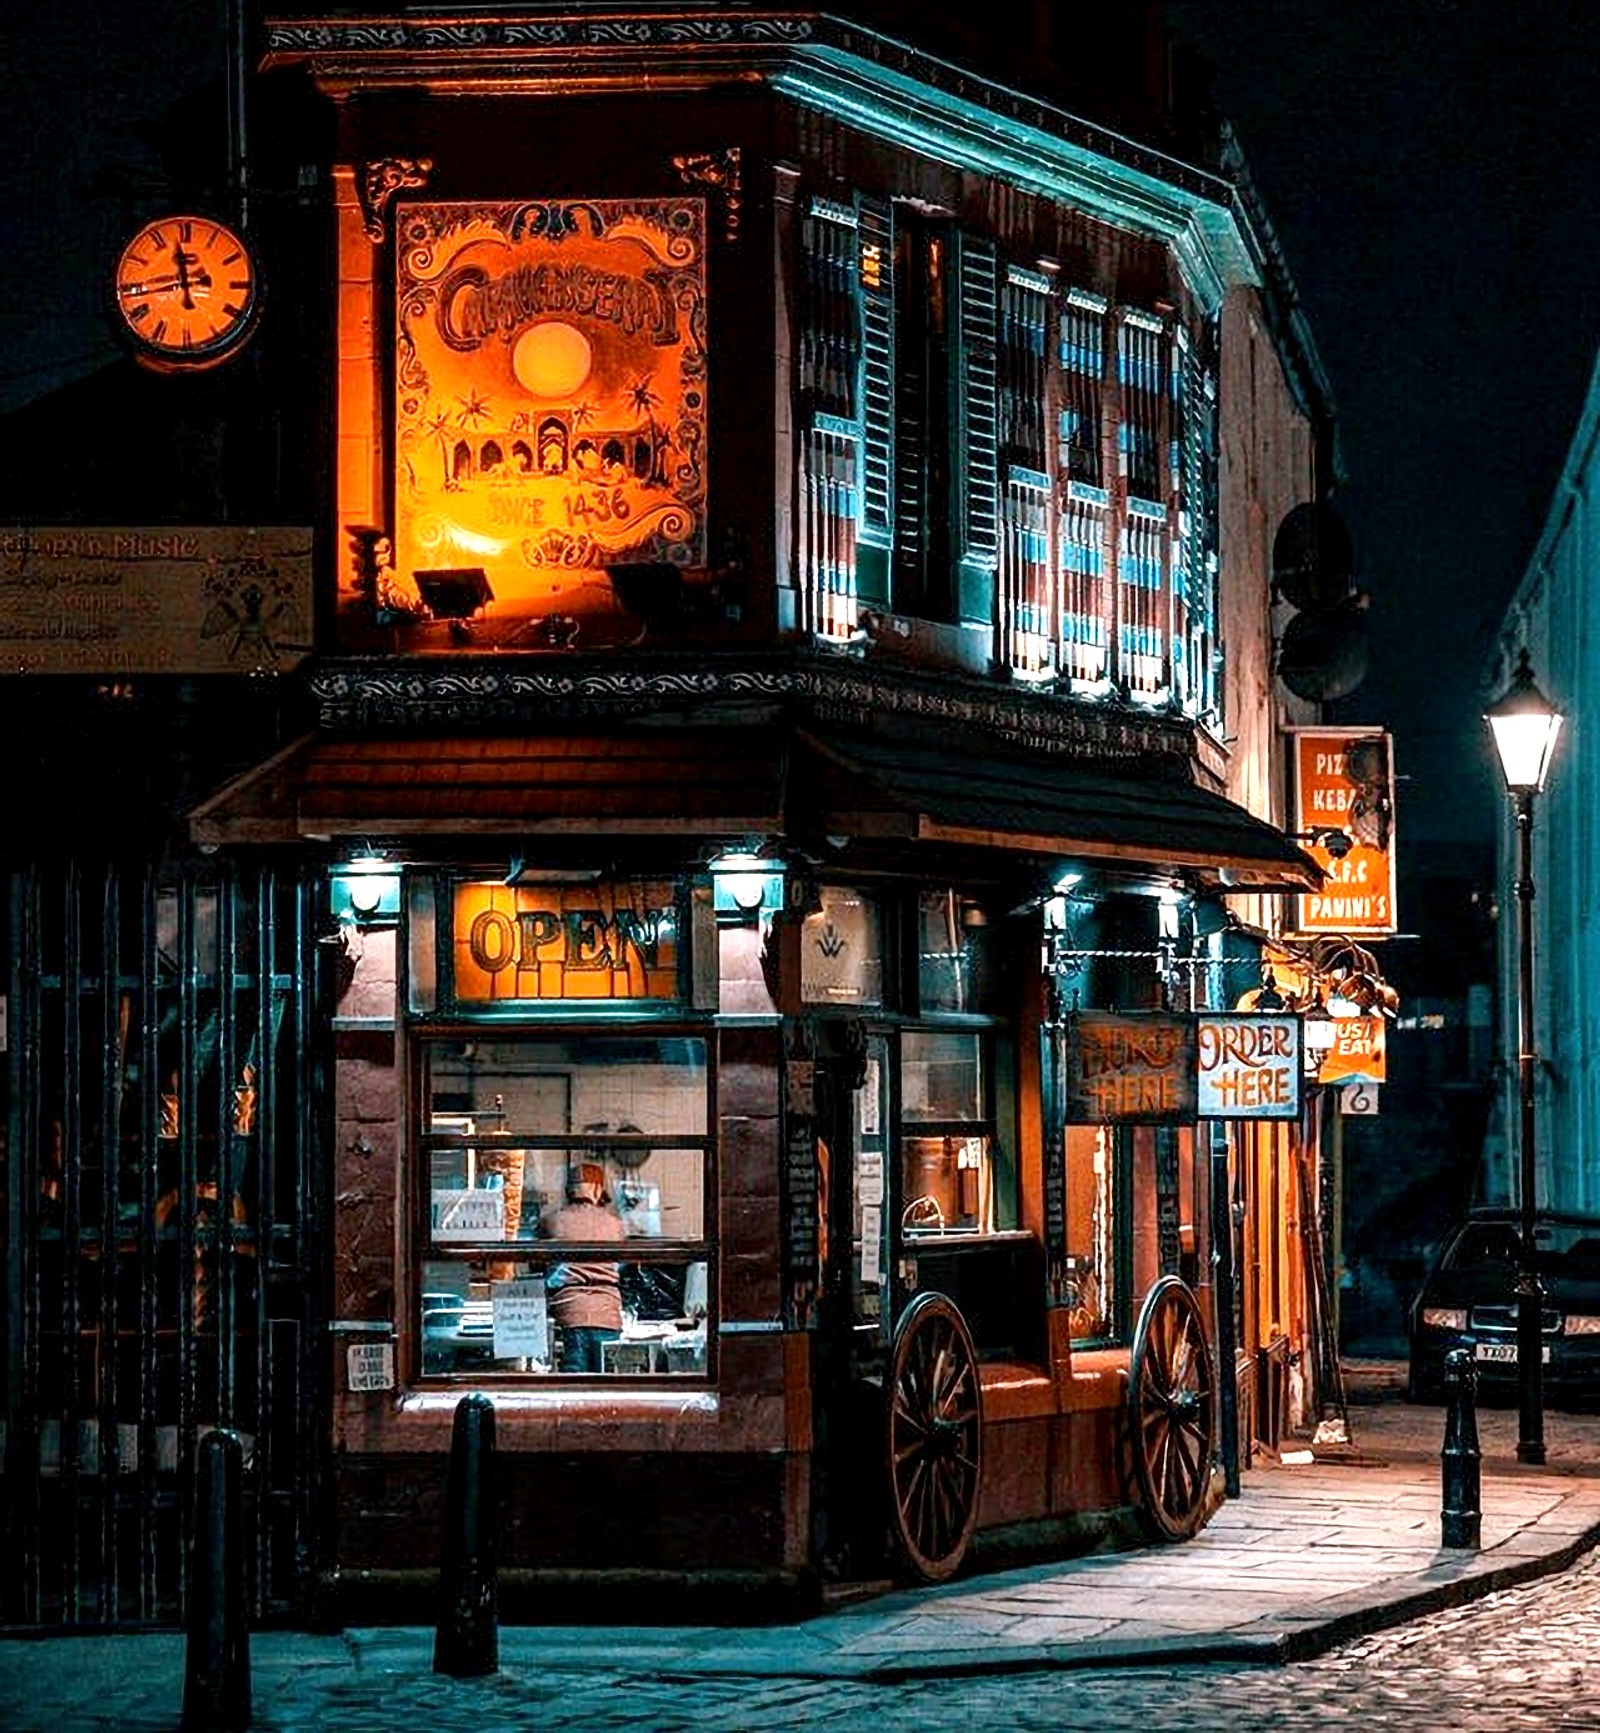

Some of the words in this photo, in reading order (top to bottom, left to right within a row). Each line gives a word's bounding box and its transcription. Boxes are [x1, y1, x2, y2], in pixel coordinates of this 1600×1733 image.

[471, 909, 675, 973] OPEN
[1199, 1024, 1294, 1071] ORDER
[1339, 1038, 1372, 1056] EAT
[1211, 1068, 1291, 1108] HERE
[1349, 1084, 1371, 1112] 6
